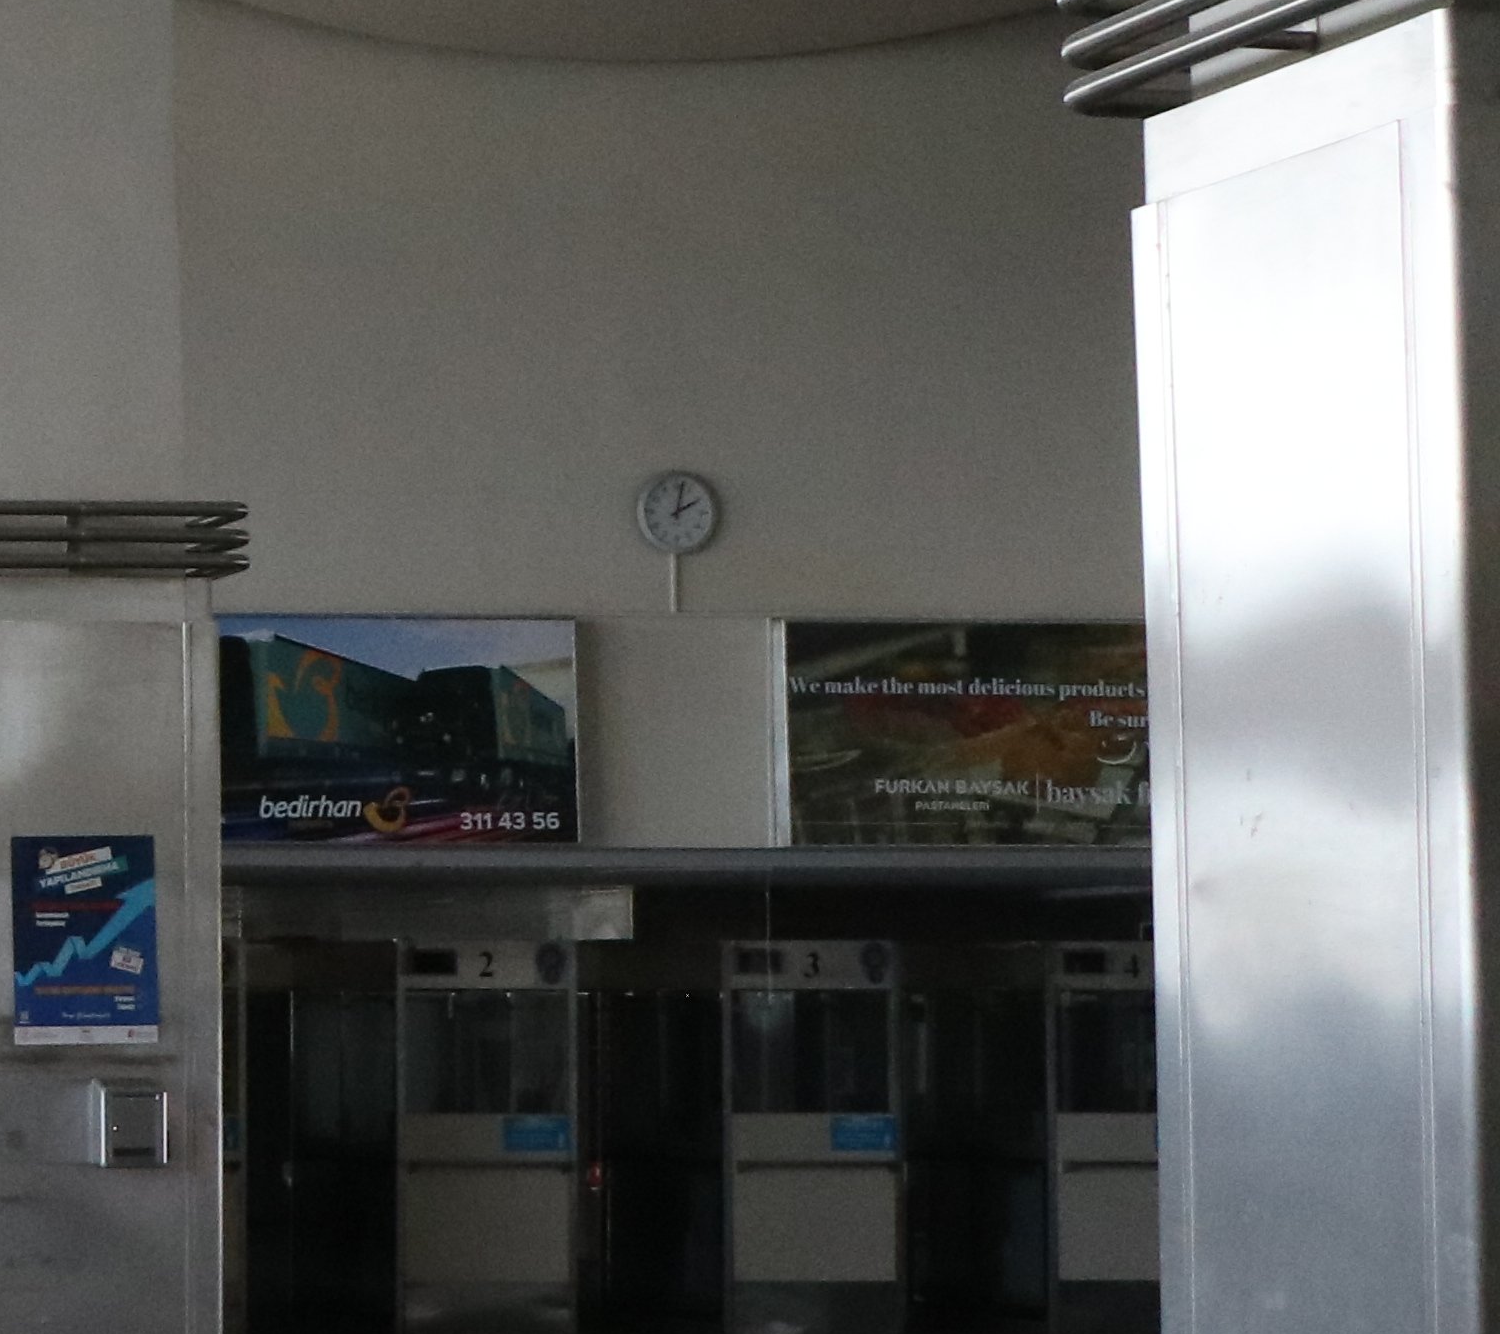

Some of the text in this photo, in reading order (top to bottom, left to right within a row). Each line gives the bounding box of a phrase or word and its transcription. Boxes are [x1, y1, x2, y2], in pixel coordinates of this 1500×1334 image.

[788, 676, 1146, 701] We make the most delicious products
[1089, 709, 1114, 728] Be
[875, 778, 1029, 796] FURKAN BAYSAK
[259, 794, 362, 819] bedirhan
[460, 811, 561, 830] 311 43 56
[479, 950, 495, 978] 2
[803, 950, 821, 979] 3
[1123, 952, 1141, 979] 4
